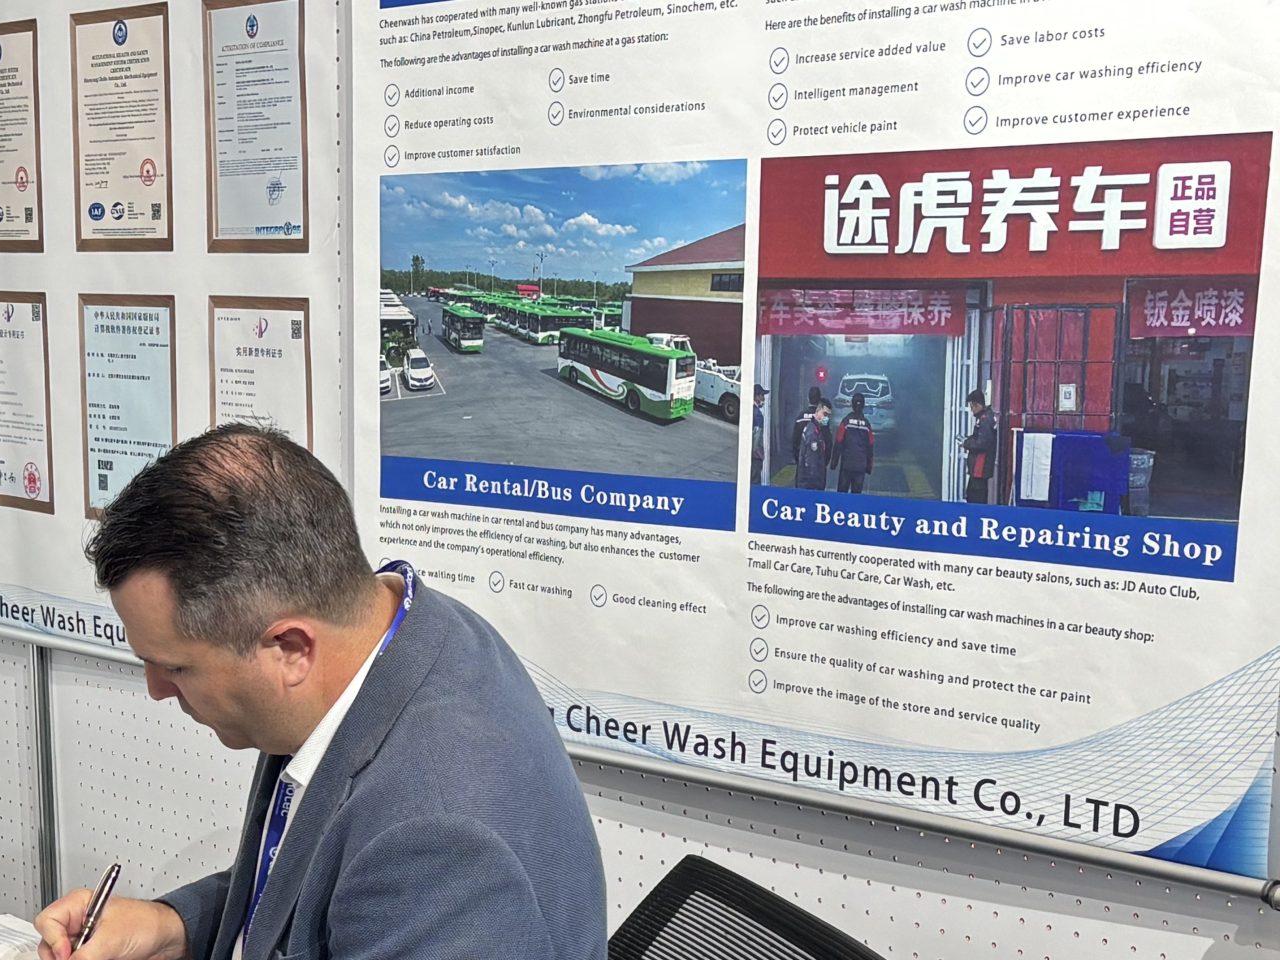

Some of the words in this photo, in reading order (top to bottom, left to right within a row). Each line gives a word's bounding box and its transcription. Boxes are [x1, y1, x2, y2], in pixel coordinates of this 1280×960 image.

[1000, 34, 1030, 46] Save
[1034, 30, 1068, 43] labor
[1072, 28, 1105, 40] costs
[795, 52, 836, 64] Increase
[839, 48, 875, 61] service
[878, 42, 912, 57] added
[916, 40, 946, 53] value
[568, 74, 588, 85] Save
[590, 72, 610, 83] time
[998, 73, 1051, 87] Improve
[1055, 71, 1075, 82] car
[1079, 65, 1133, 79] washing
[1138, 60, 1202, 75] efficiency
[404, 86, 444, 99] Additional
[446, 86, 474, 95] income
[794, 87, 846, 101] Intelligent
[849, 82, 918, 97] management
[633, 101, 706, 115] considerations
[996, 116, 1048, 129] Improve
[1052, 111, 1114, 124] customer
[1117, 105, 1190, 122] experience
[404, 120, 432, 130] Reduce
[433, 116, 472, 130] operating
[473, 116, 494, 125] costs
[793, 125, 828, 136] Protect
[831, 121, 867, 134] vehicle
[870, 120, 897, 134] paint
[404, 151, 436, 162] Improve
[437, 149, 474, 159] customer
[475, 145, 521, 156] satisfaction
[1170, 173, 1217, 201] 正品
[823, 166, 1151, 254] 途虎养车
[1169, 208, 1216, 237] 自营
[1144, 288, 1246, 328] 钣金喷漆
[423, 470, 458, 490] Car
[464, 474, 572, 502] Rental/Bus
[580, 484, 684, 515] Company
[762, 498, 806, 521] Car
[814, 503, 906, 536] Beauty
[915, 516, 968, 538] and
[979, 517, 1130, 557] Repairing
[1142, 532, 1222, 566] Shop
[427, 570, 456, 583] waiting
[457, 572, 475, 583] time
[747, 557, 772, 570] Tmall
[773, 560, 790, 572] Car
[790, 562, 814, 576] Care,
[815, 565, 839, 578] Tuhu
[840, 568, 856, 580] Car
[857, 570, 882, 585] Care,
[884, 574, 901, 586] Car
[903, 576, 934, 591] Wash,
[936, 581, 955, 592] etc.
[509, 579, 525, 590] Fast
[526, 584, 539, 592] car
[540, 586, 572, 599] washing
[612, 593, 636, 605] Good
[638, 596, 677, 612] cleaning
[679, 601, 706, 614] effect
[40, 604, 87, 635] Wash
[776, 614, 817, 629] Improve
[819, 622, 835, 632] car
[836, 624, 878, 641] washing
[880, 629, 934, 648] efficiency
[936, 637, 958, 648] and
[961, 641, 987, 652] save
[990, 643, 1016, 656] time
[774, 647, 807, 662] Ensure
[810, 652, 826, 665] the
[829, 658, 864, 672] quality
[866, 662, 877, 672] of
[878, 666, 895, 676] car
[898, 668, 944, 685] washing
[947, 674, 970, 686] and
[972, 678, 1014, 692] protect
[1017, 683, 1036, 696] the
[1039, 688, 1058, 698] car
[1060, 691, 1091, 704] paint
[773, 679, 814, 695] Improve
[816, 686, 833, 698] the
[836, 689, 866, 705] image
[868, 696, 880, 706] of
[882, 697, 900, 710] the
[902, 702, 931, 714] store
[933, 707, 955, 718] and
[958, 711, 998, 725] service
[1000, 718, 1041, 734] quality
[566, 704, 652, 745] Cheer
[662, 720, 747, 764] Wash
[760, 738, 959, 805] Equipment
[973, 778, 1046, 828] Co.,
[1063, 793, 1140, 839] LTD
